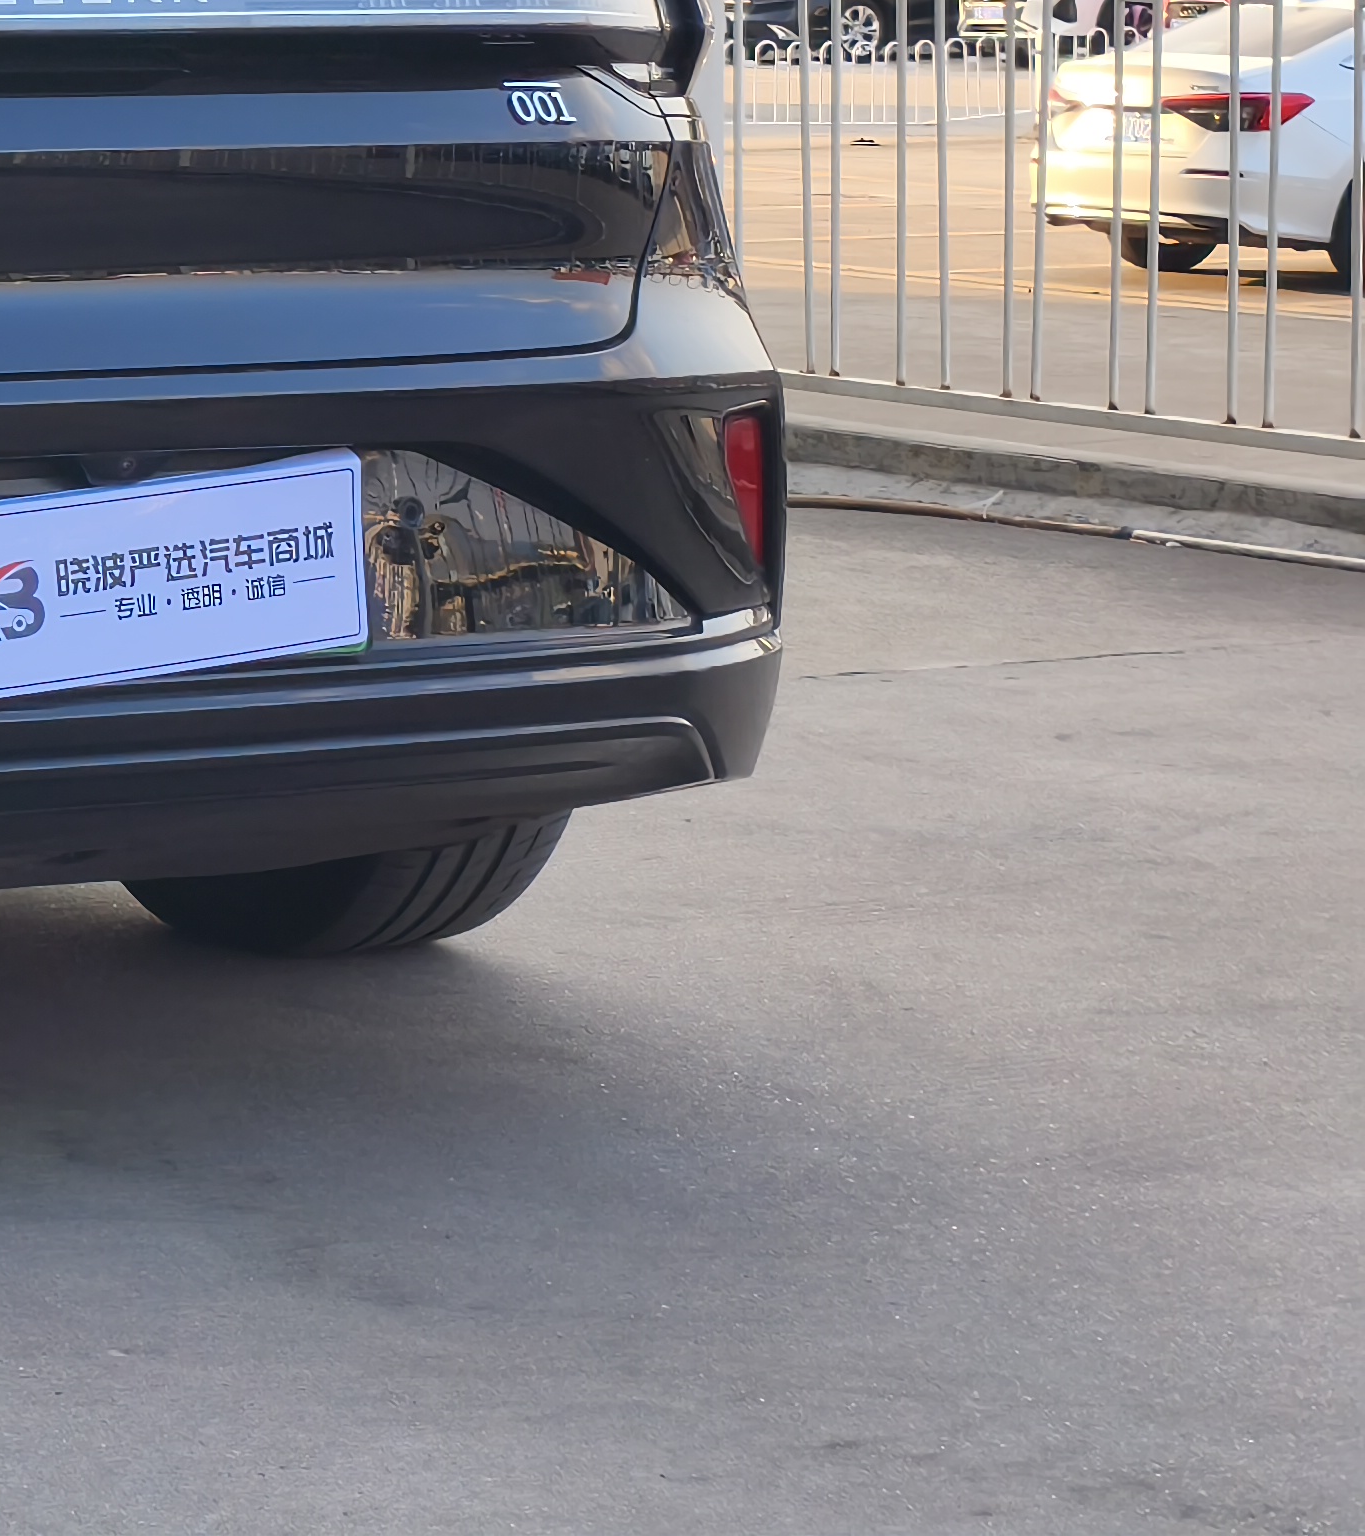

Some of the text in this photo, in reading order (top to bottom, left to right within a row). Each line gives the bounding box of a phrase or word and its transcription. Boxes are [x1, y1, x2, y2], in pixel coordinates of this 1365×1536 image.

[511, 90, 577, 122] 001
[54, 521, 336, 597] 晓波严选汽车商城
